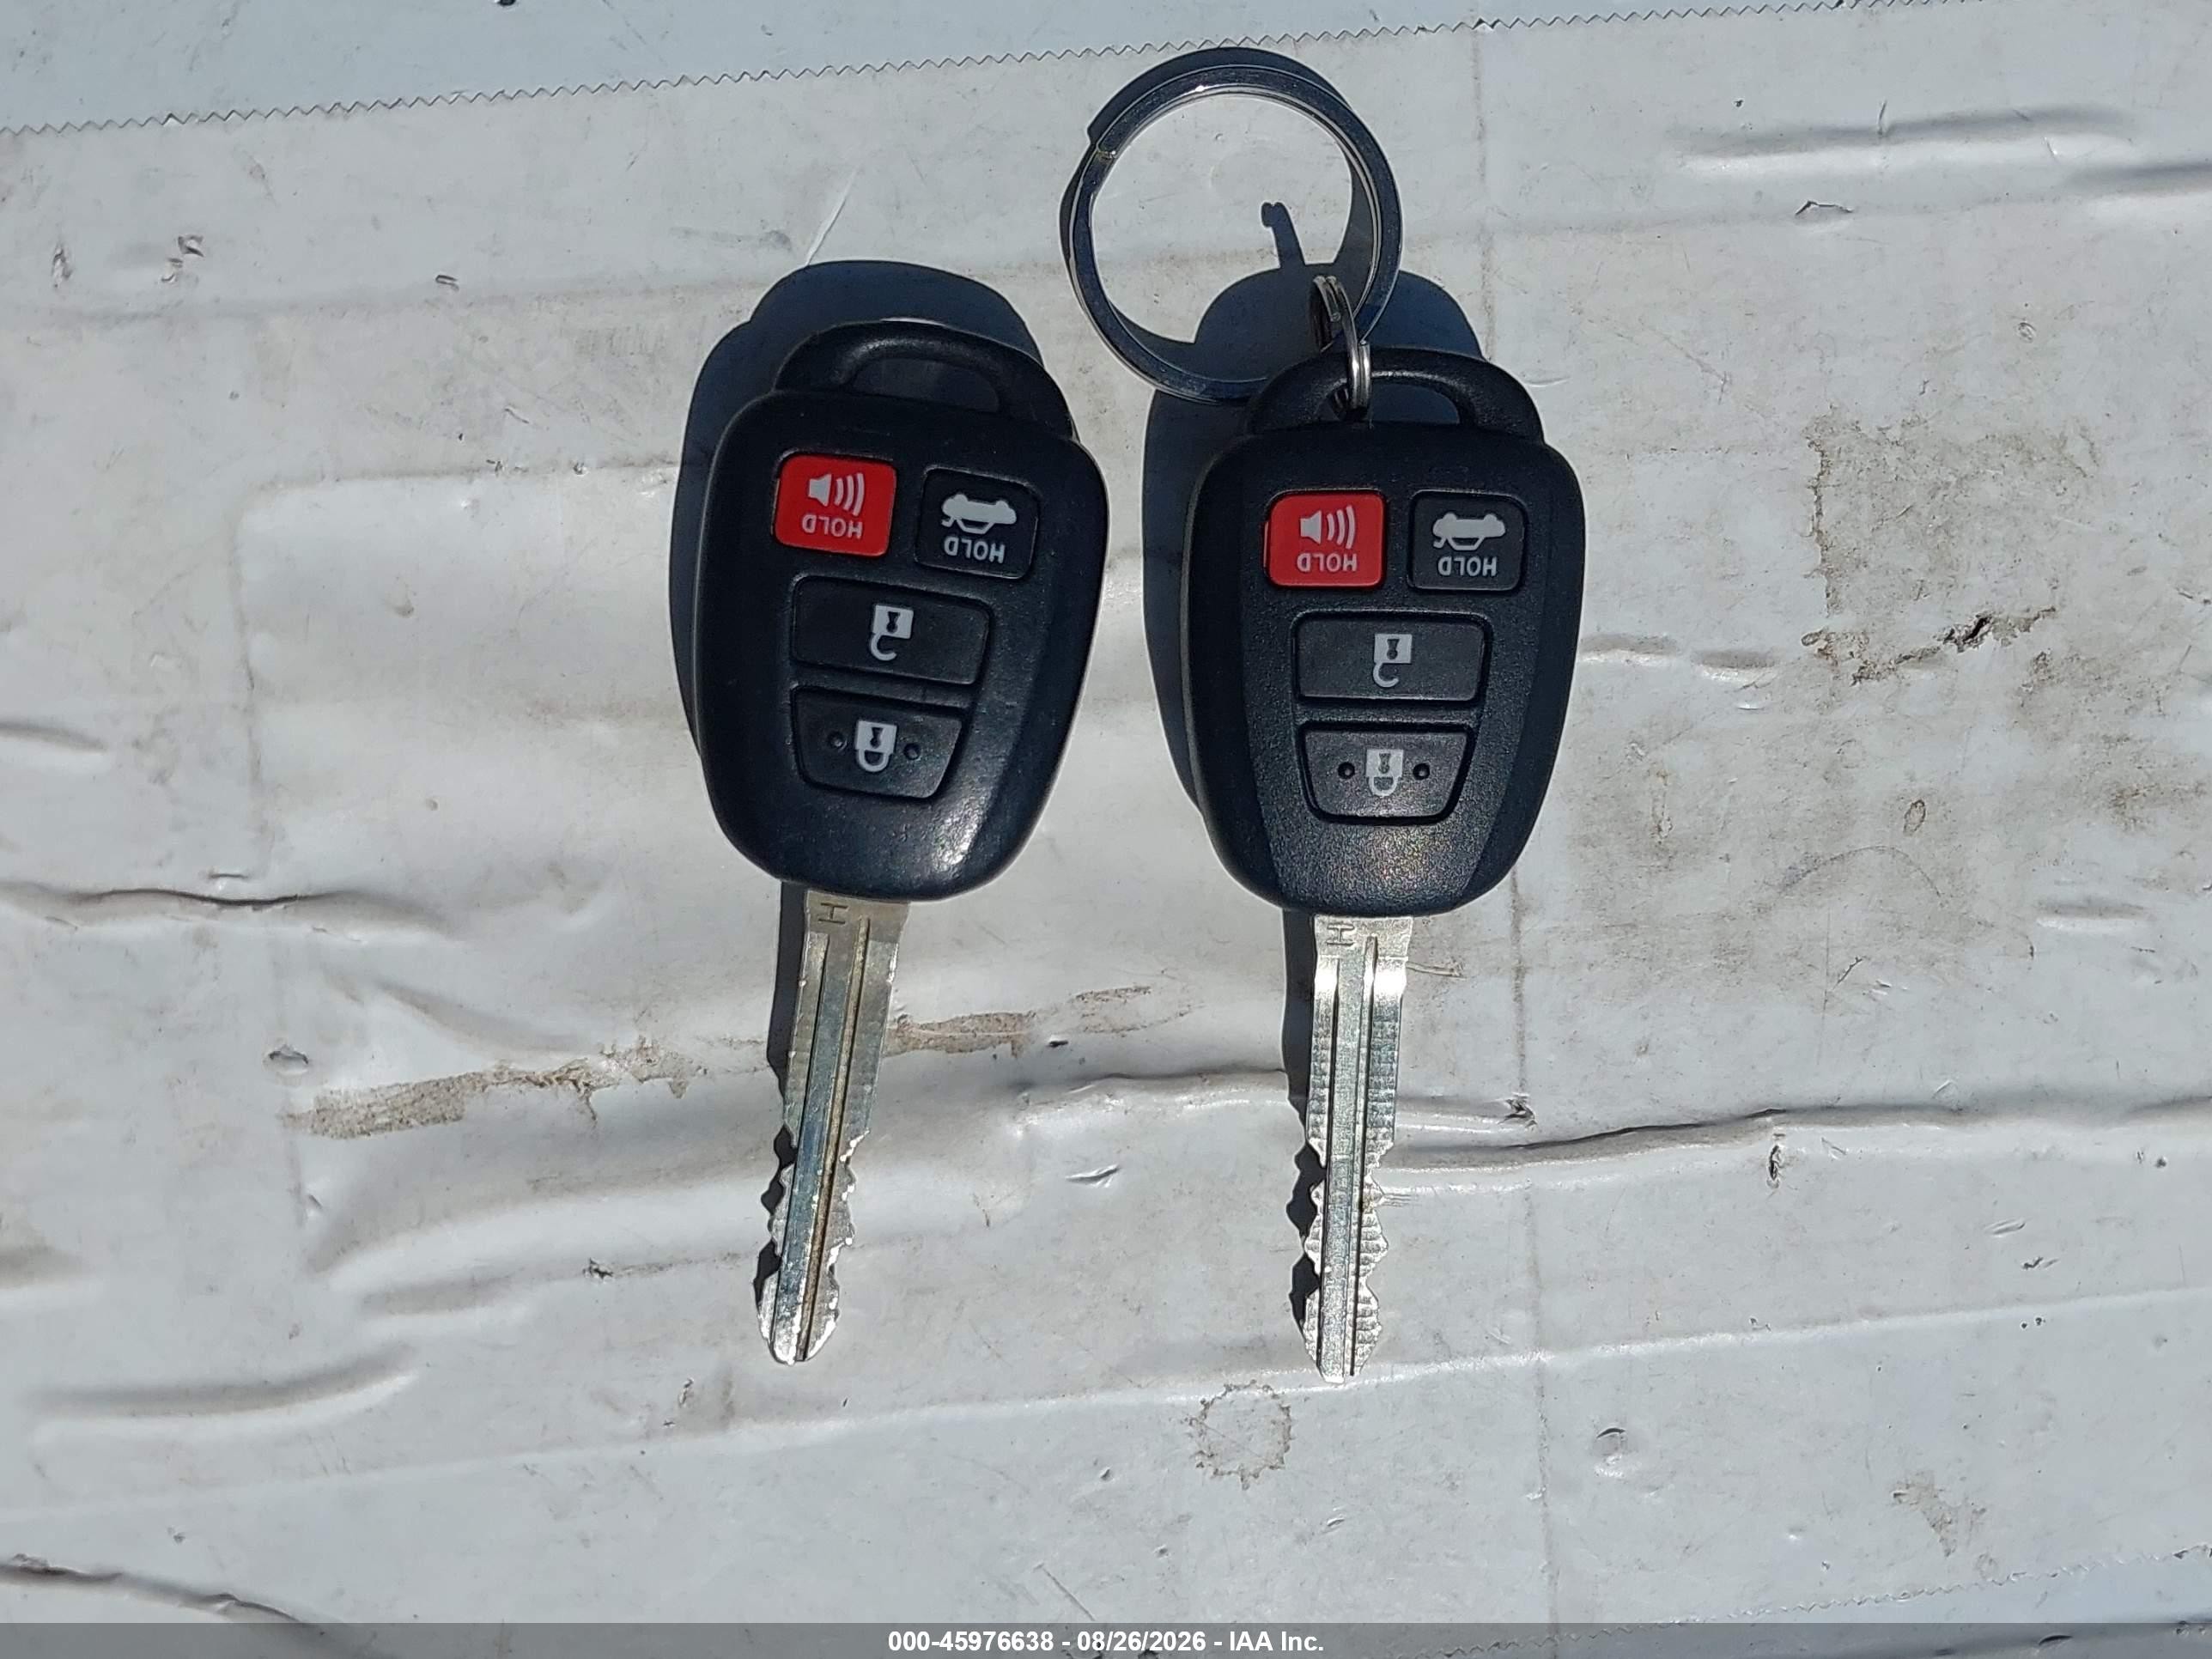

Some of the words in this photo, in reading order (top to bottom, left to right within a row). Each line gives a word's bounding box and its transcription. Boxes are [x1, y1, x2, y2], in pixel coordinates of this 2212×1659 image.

[802, 514, 863, 539] HOLD
[944, 536, 1006, 564] HOLD
[1297, 553, 1358, 573] HOLD
[1437, 556, 1498, 577] HOLD
